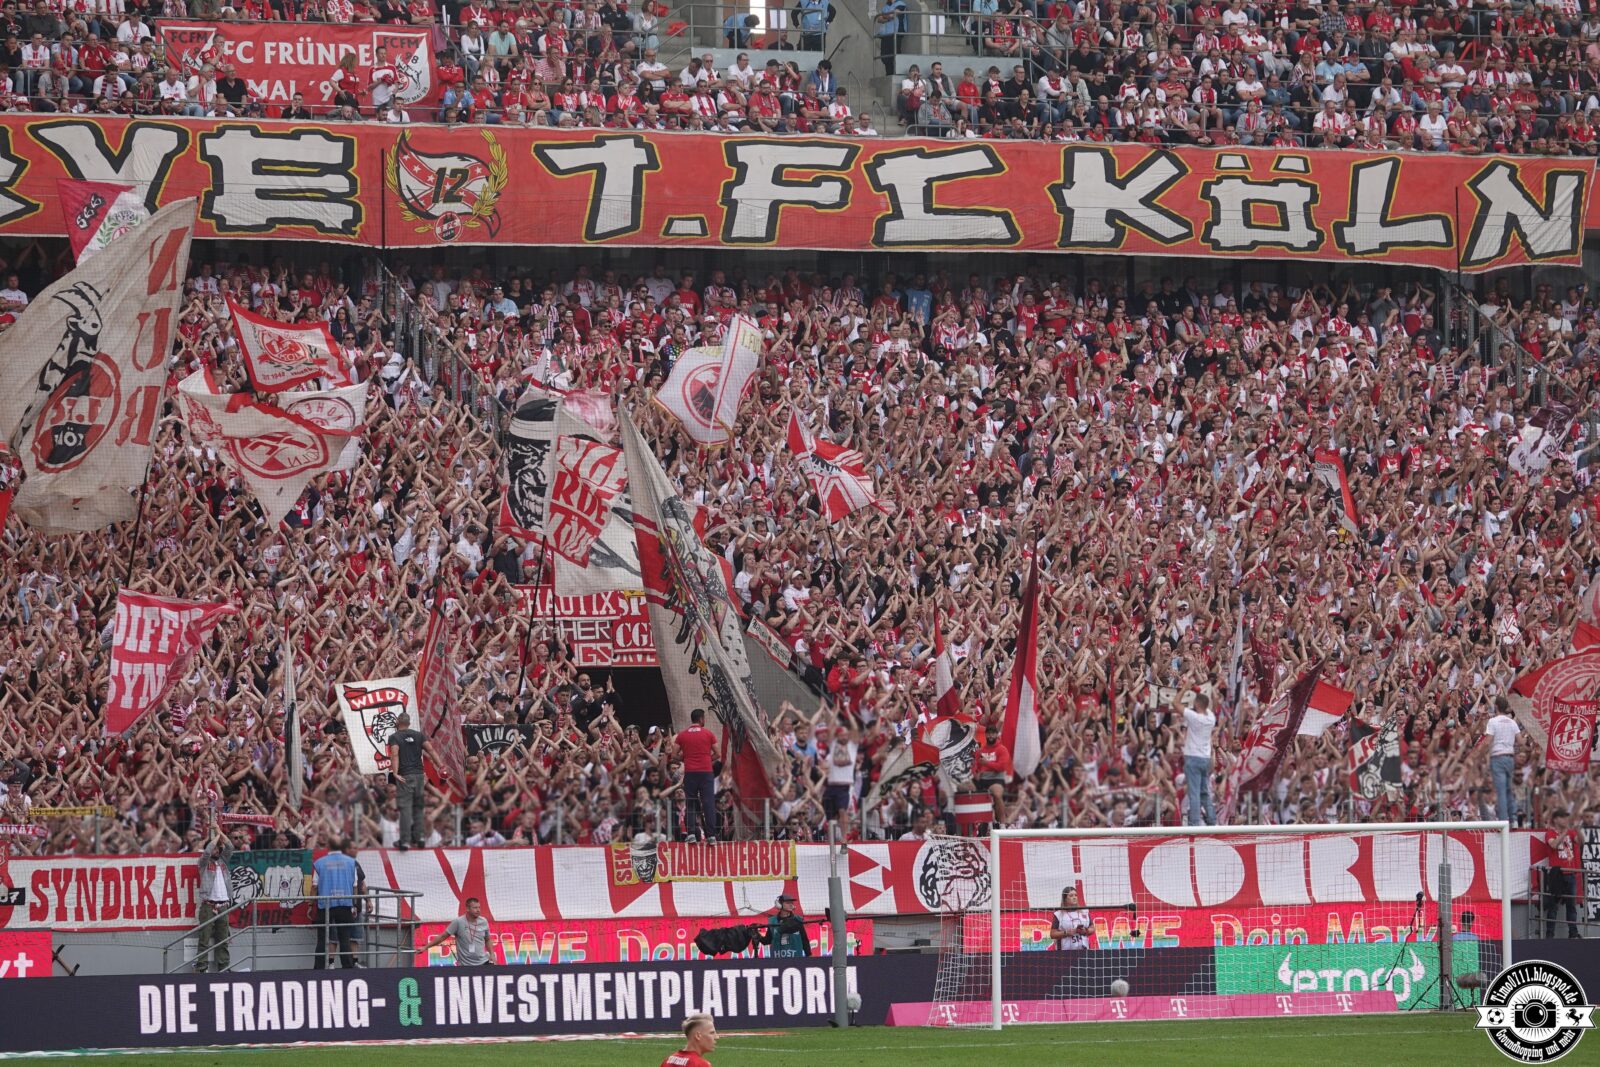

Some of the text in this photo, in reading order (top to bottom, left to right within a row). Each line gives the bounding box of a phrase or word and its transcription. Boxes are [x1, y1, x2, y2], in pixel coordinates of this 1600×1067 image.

[432, 166, 469, 203] 12
[1047, 146, 1589, 268] KÖLN
[351, 690, 405, 710] WILDE
[657, 840, 790, 878] STADIONVERBOT
[29, 864, 200, 922] SYNDIKAT
[774, 949, 797, 958] HOST
[139, 964, 858, 1034] DIE TRADING- & INVESTMENTPLATTFORM
